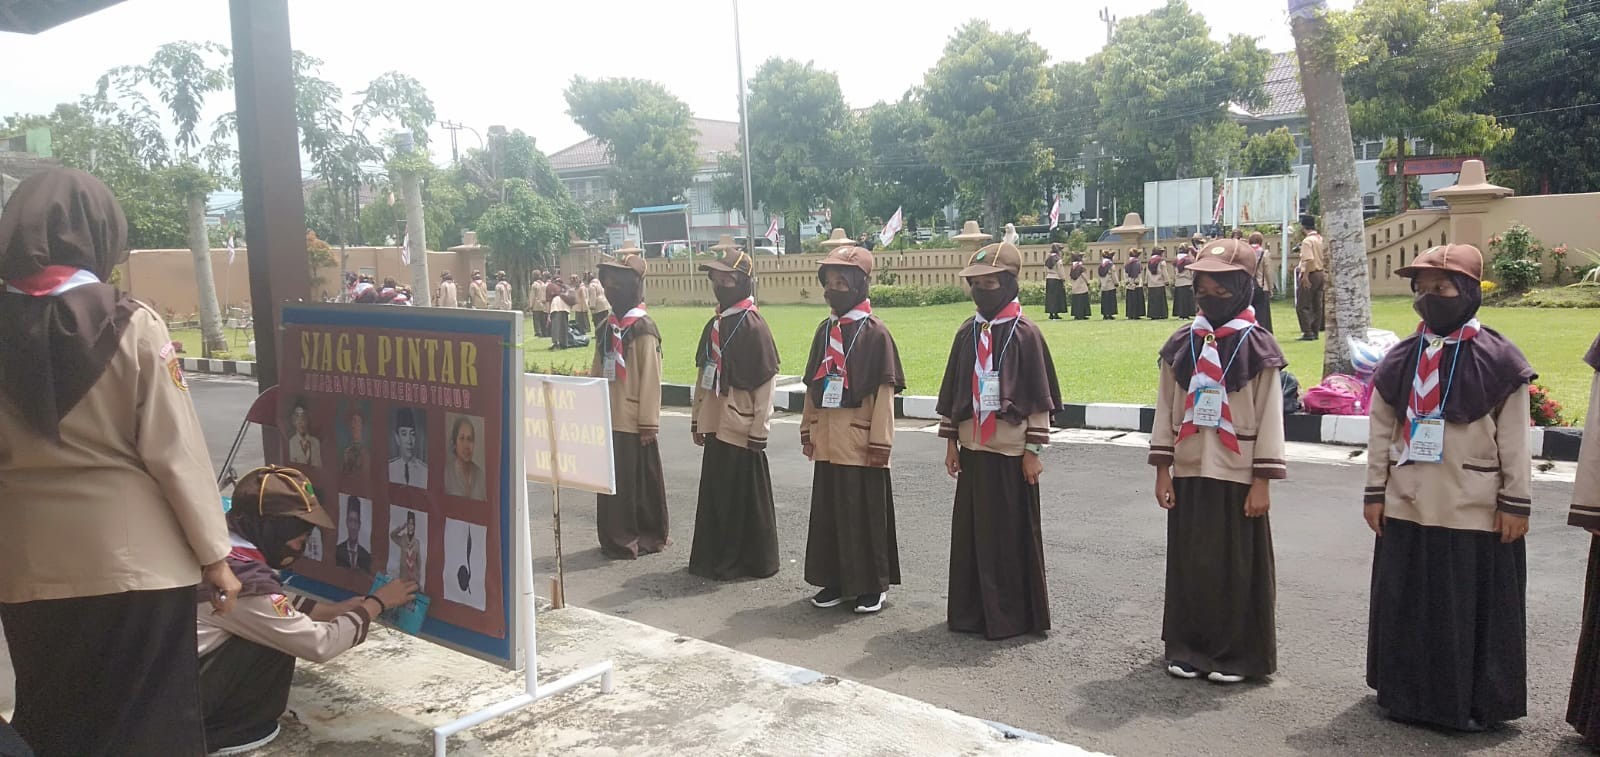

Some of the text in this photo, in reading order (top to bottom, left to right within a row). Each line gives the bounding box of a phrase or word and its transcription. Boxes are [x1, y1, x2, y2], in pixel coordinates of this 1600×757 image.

[301, 331, 478, 386] SIAGA PINTAR
[431, 385, 472, 409] TIMUR
